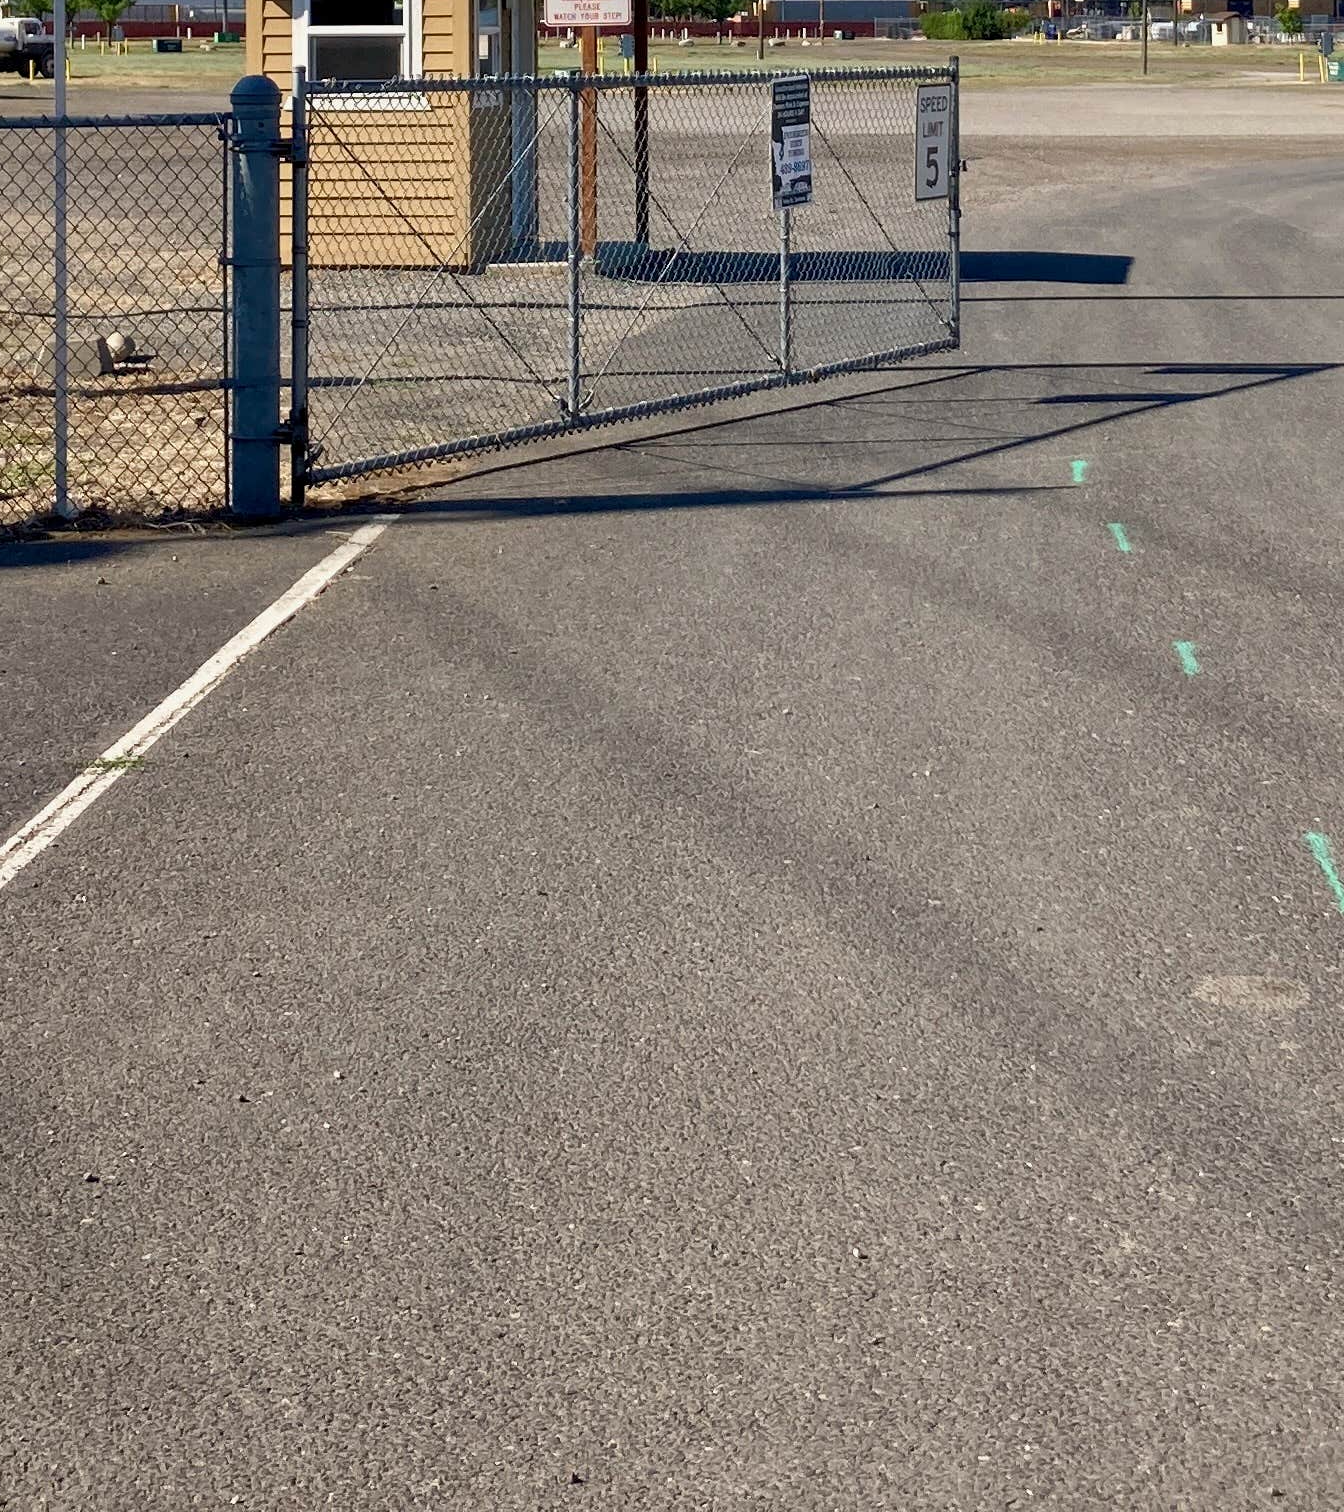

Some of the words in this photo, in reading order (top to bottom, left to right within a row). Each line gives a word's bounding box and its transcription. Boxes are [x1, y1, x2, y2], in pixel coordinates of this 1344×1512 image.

[574, 3, 601, 11] PLEASE
[554, 13, 576, 21] WATCH
[580, 12, 599, 20] YOUR
[920, 95, 948, 114] SPEED
[922, 121, 944, 138] LIMIT
[926, 146, 939, 189] 5
